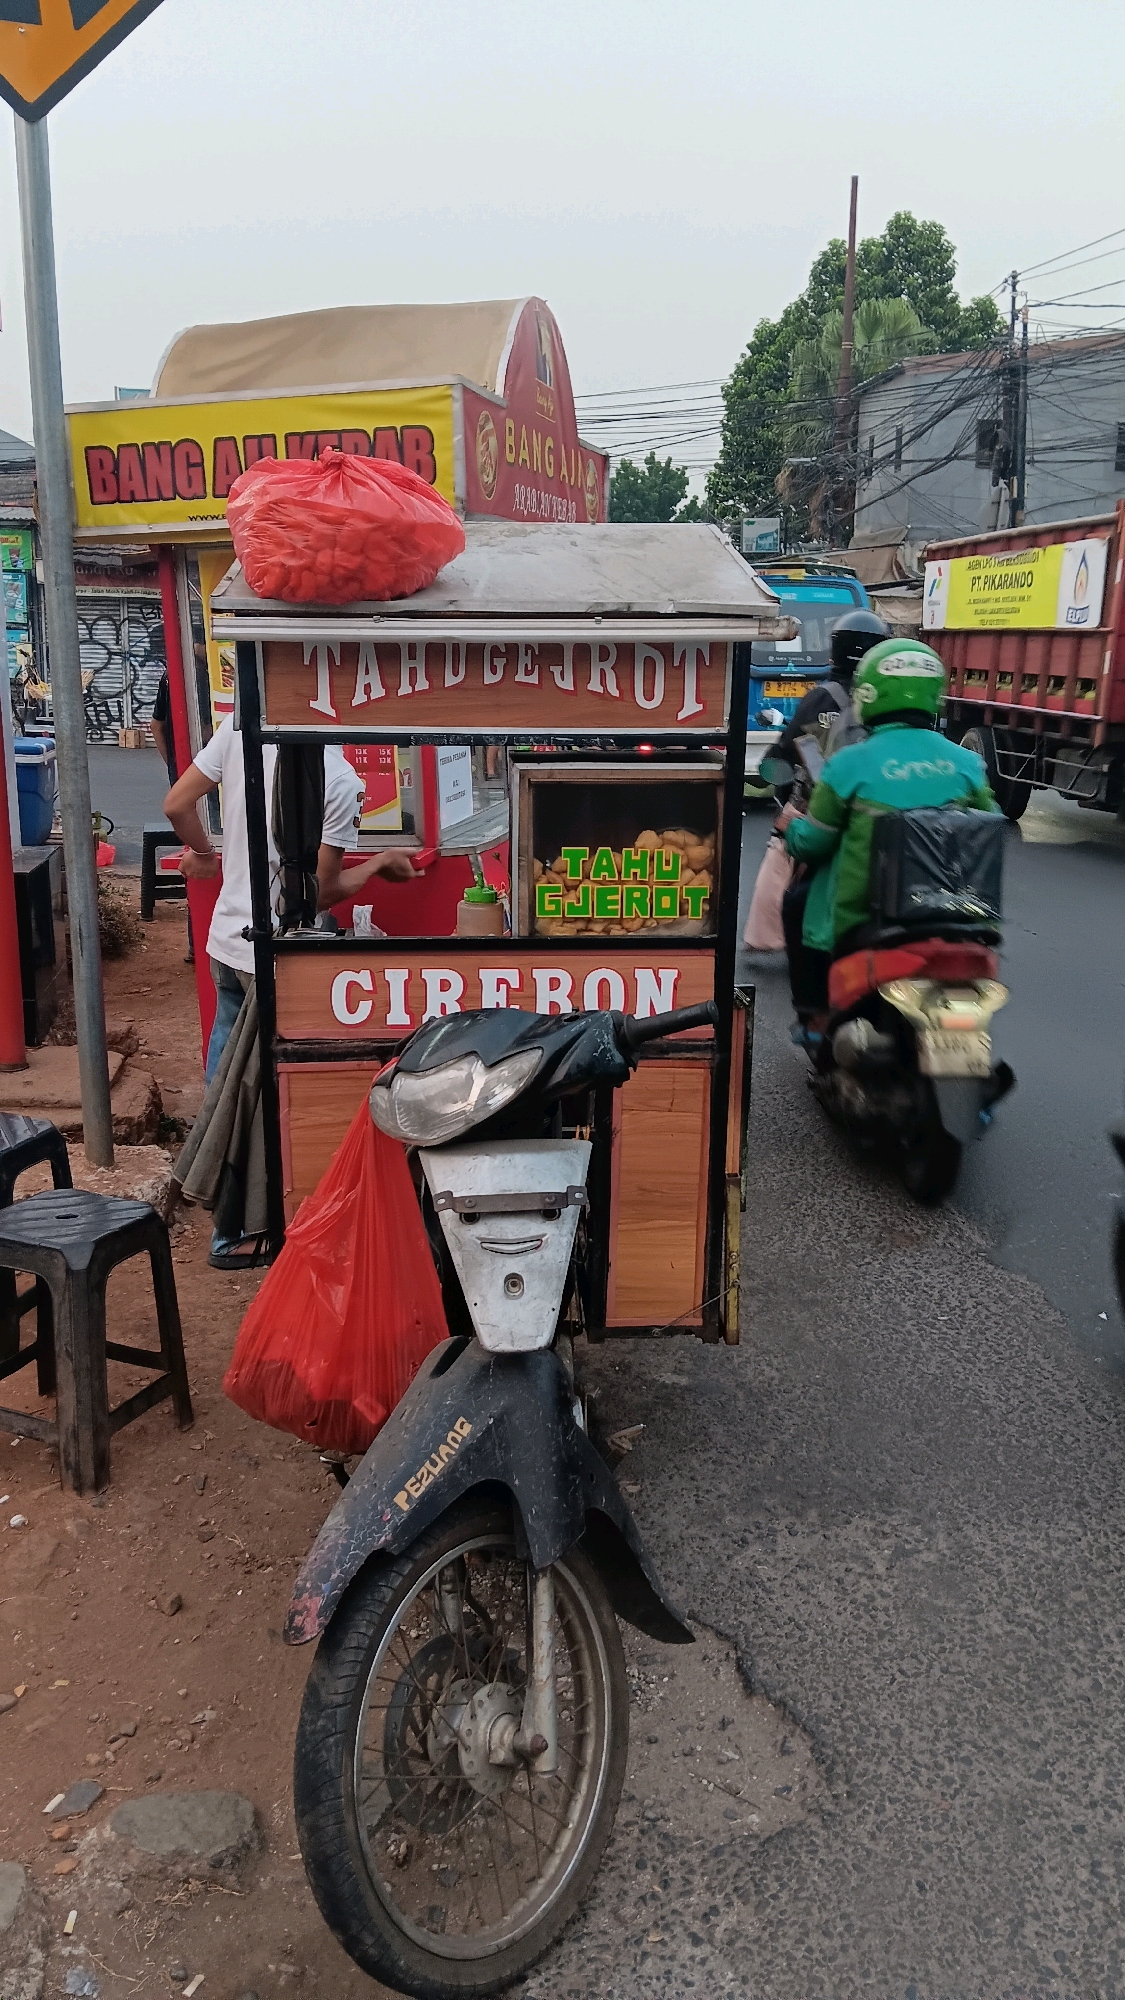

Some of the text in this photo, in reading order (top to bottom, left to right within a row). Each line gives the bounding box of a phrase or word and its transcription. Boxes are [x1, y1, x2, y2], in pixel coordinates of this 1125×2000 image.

[85, 438, 206, 505] BANG
[505, 417, 585, 489] BANG AJI
[551, 494, 577, 523] KEBAB
[970, 570, 1034, 593] PT. PIKARANDO
[303, 641, 711, 722] TAHU GEJROT
[561, 846, 683, 883] TAHU
[535, 884, 710, 920] GJEROT
[330, 966, 681, 1028] CIREBON
